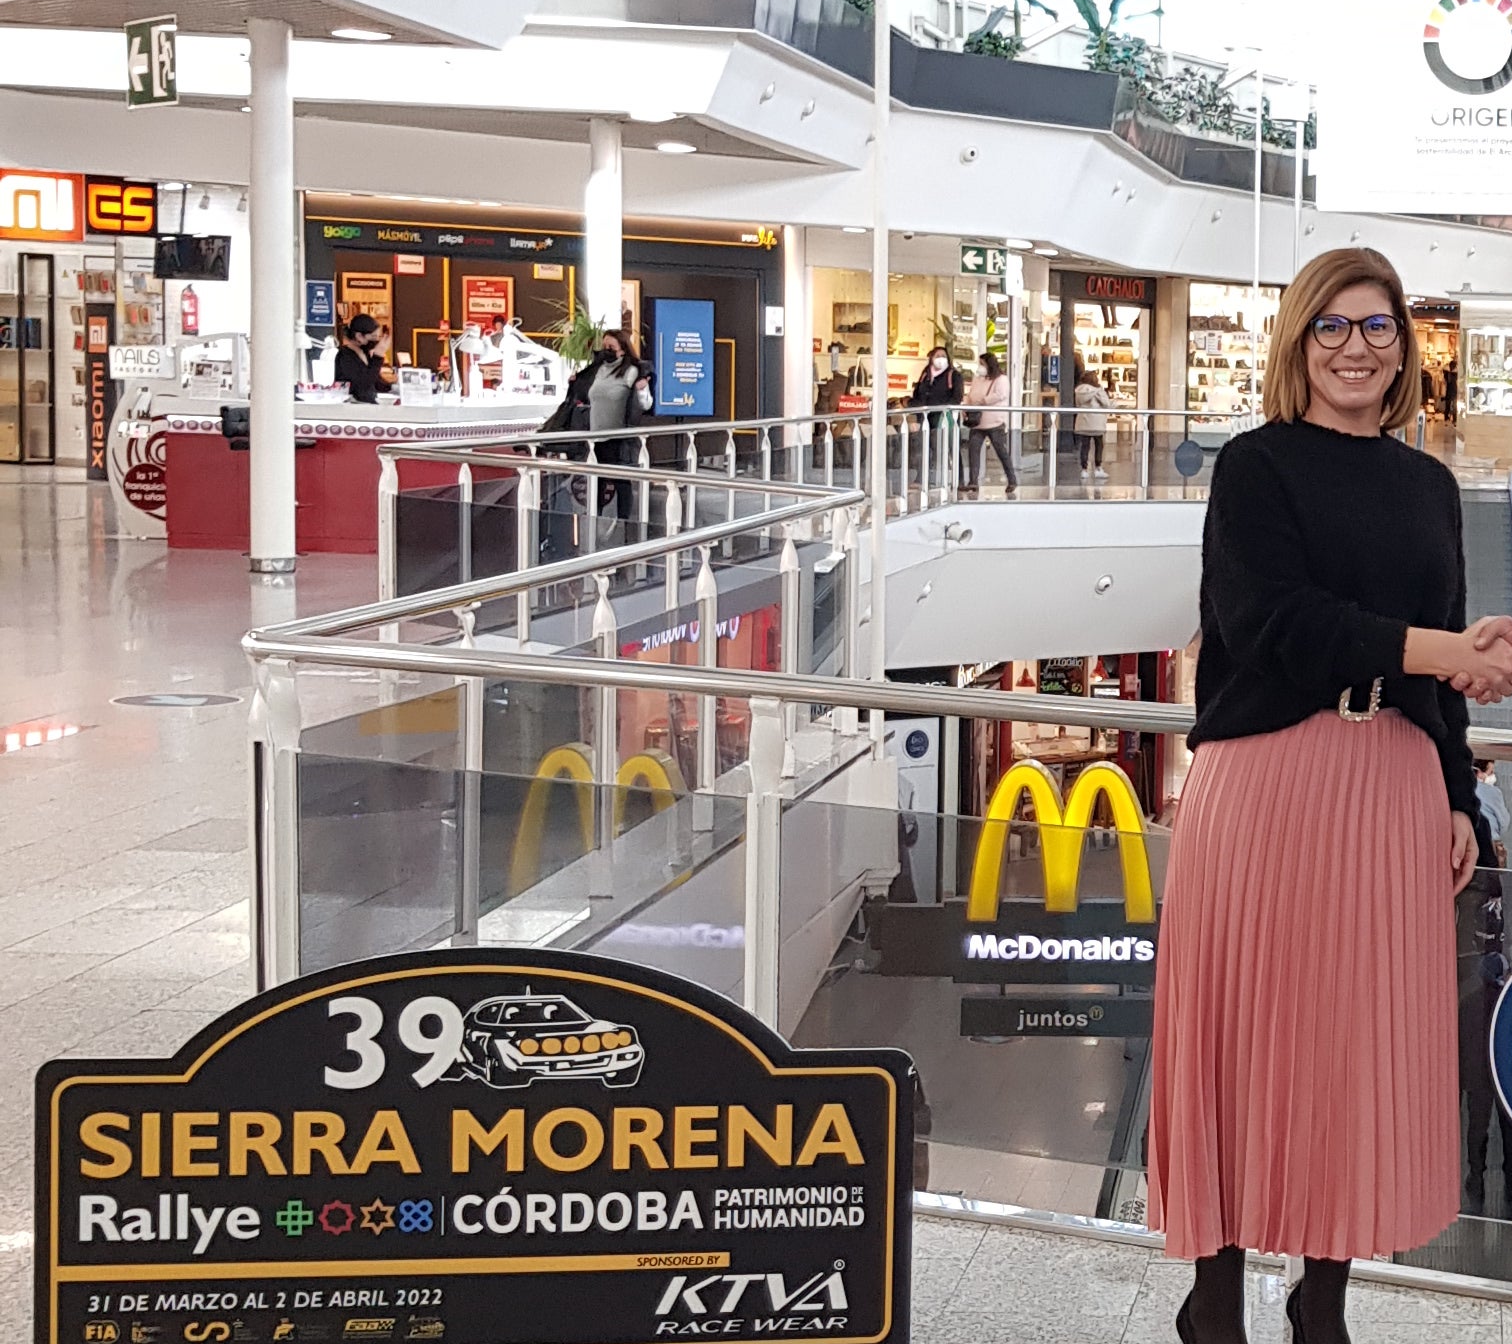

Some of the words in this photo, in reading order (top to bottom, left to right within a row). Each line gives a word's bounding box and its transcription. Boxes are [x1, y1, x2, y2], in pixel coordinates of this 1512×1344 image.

[324, 225, 361, 239] yoigo
[1086, 275, 1145, 299] CATCHALOT
[114, 349, 160, 365] NAILS
[92, 362, 104, 468] xiaomi
[967, 934, 1155, 961] McDonald's
[1017, 1010, 1089, 1031] juntos
[323, 996, 466, 1090] 39
[79, 1110, 422, 1179] SIERRA
[452, 1103, 865, 1173] MORENA
[714, 1186, 848, 1206] PATRIMONIO
[851, 1186, 864, 1195] DE
[851, 1195, 864, 1203] LA
[79, 1193, 261, 1255] Rallye
[453, 1186, 704, 1235] CÓRDOBA
[714, 1207, 865, 1230] HUMANIDAD
[637, 1256, 704, 1267] SPONSORED
[706, 1256, 721, 1265] BY
[87, 1295, 111, 1312] 31
[118, 1295, 149, 1312] DE
[154, 1292, 238, 1311] MARZO
[242, 1292, 269, 1310] AL
[275, 1291, 286, 1308] 2
[294, 1291, 323, 1308] DE
[328, 1290, 390, 1307] ABRIL
[395, 1288, 443, 1306] 2022
[85, 1324, 117, 1341] FIA
[655, 1319, 745, 1335] RACE
[754, 1316, 849, 1332] WEAR
